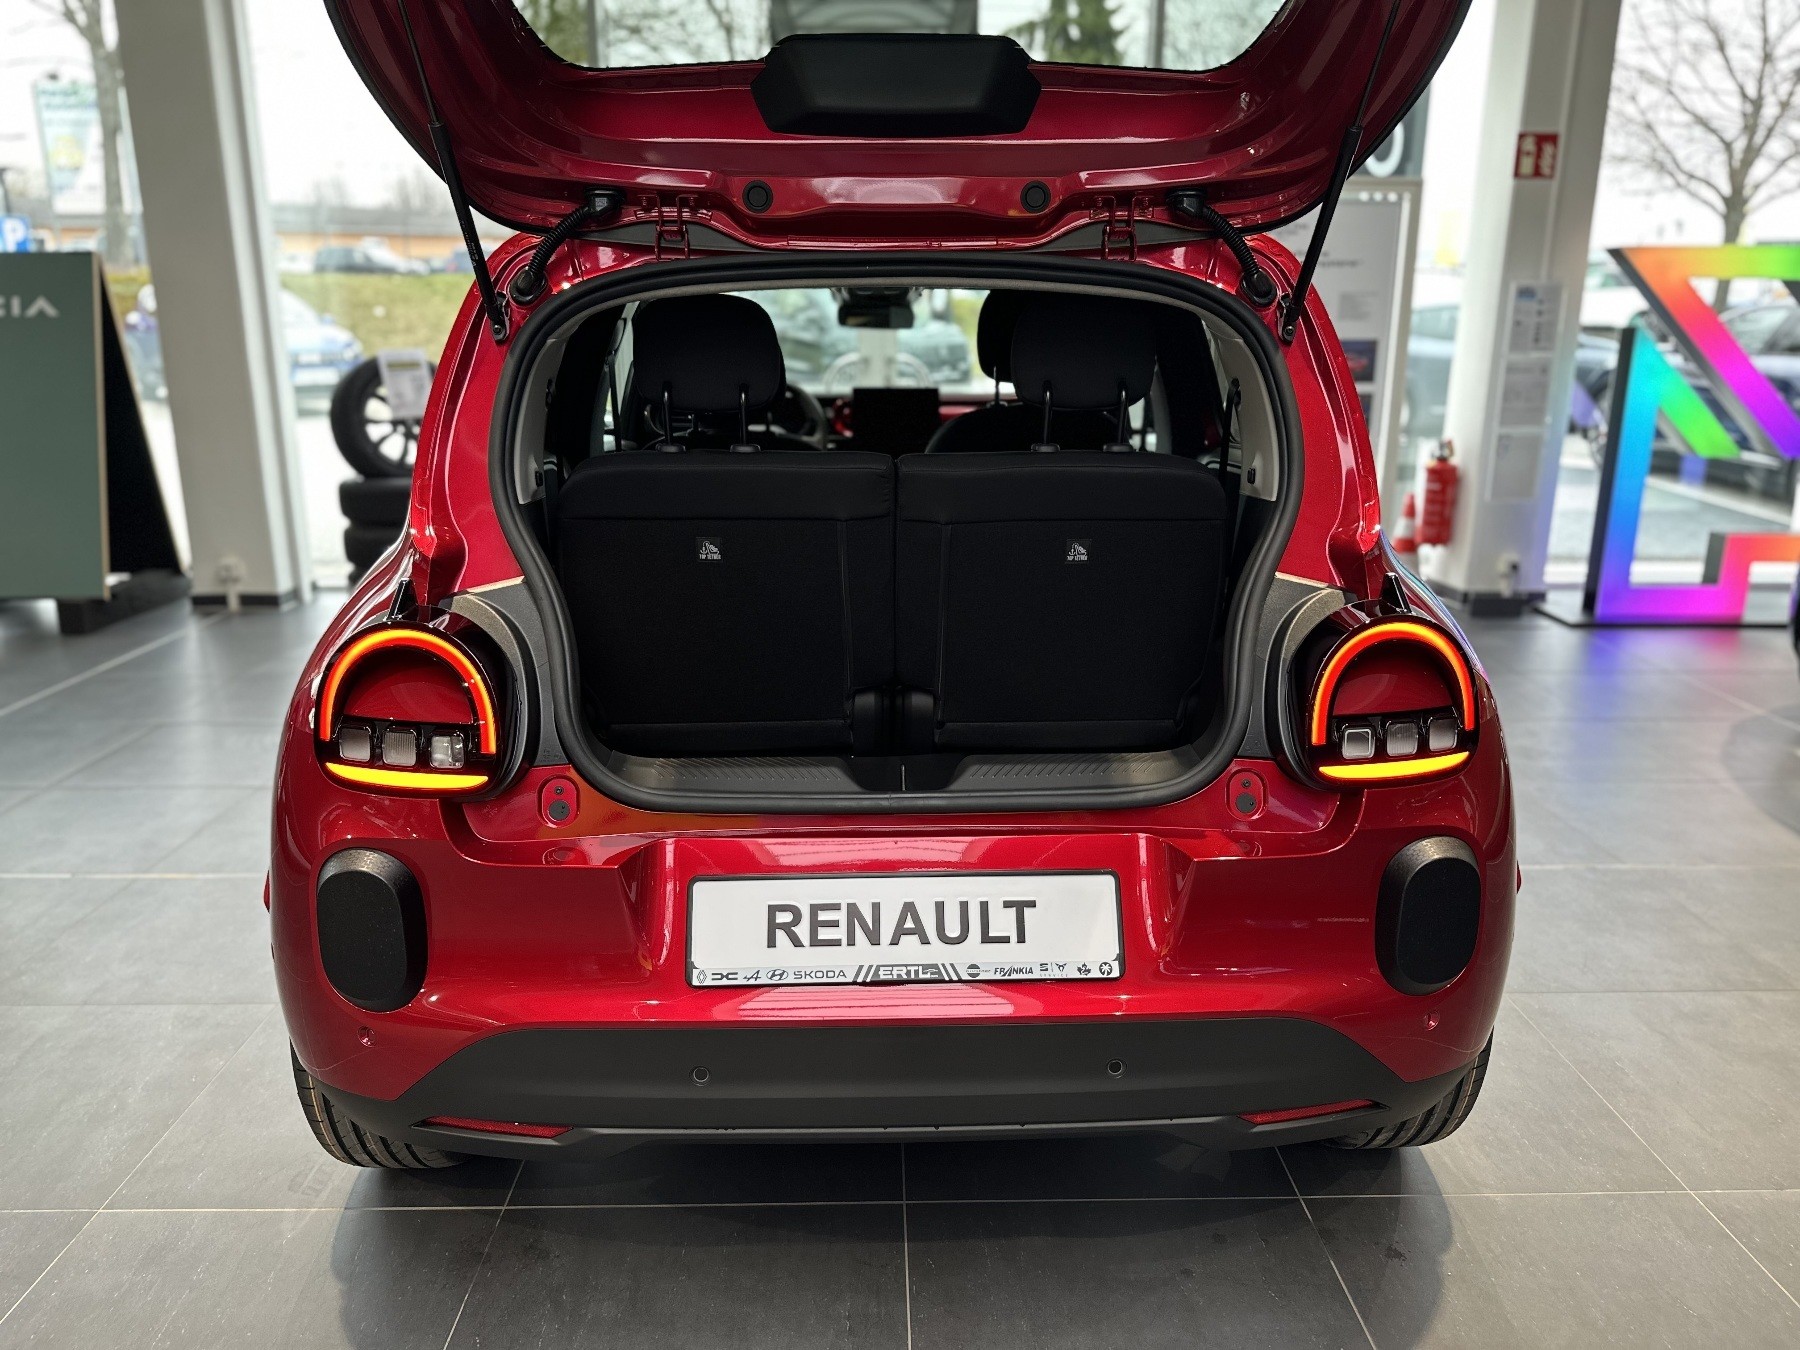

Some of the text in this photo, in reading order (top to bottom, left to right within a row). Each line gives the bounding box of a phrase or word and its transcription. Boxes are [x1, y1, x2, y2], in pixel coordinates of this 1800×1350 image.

[4, 217, 26, 252] P
[767, 899, 1036, 948] RENAULT
[879, 965, 931, 979] ERTL
[994, 965, 1034, 977] FRANKIA
